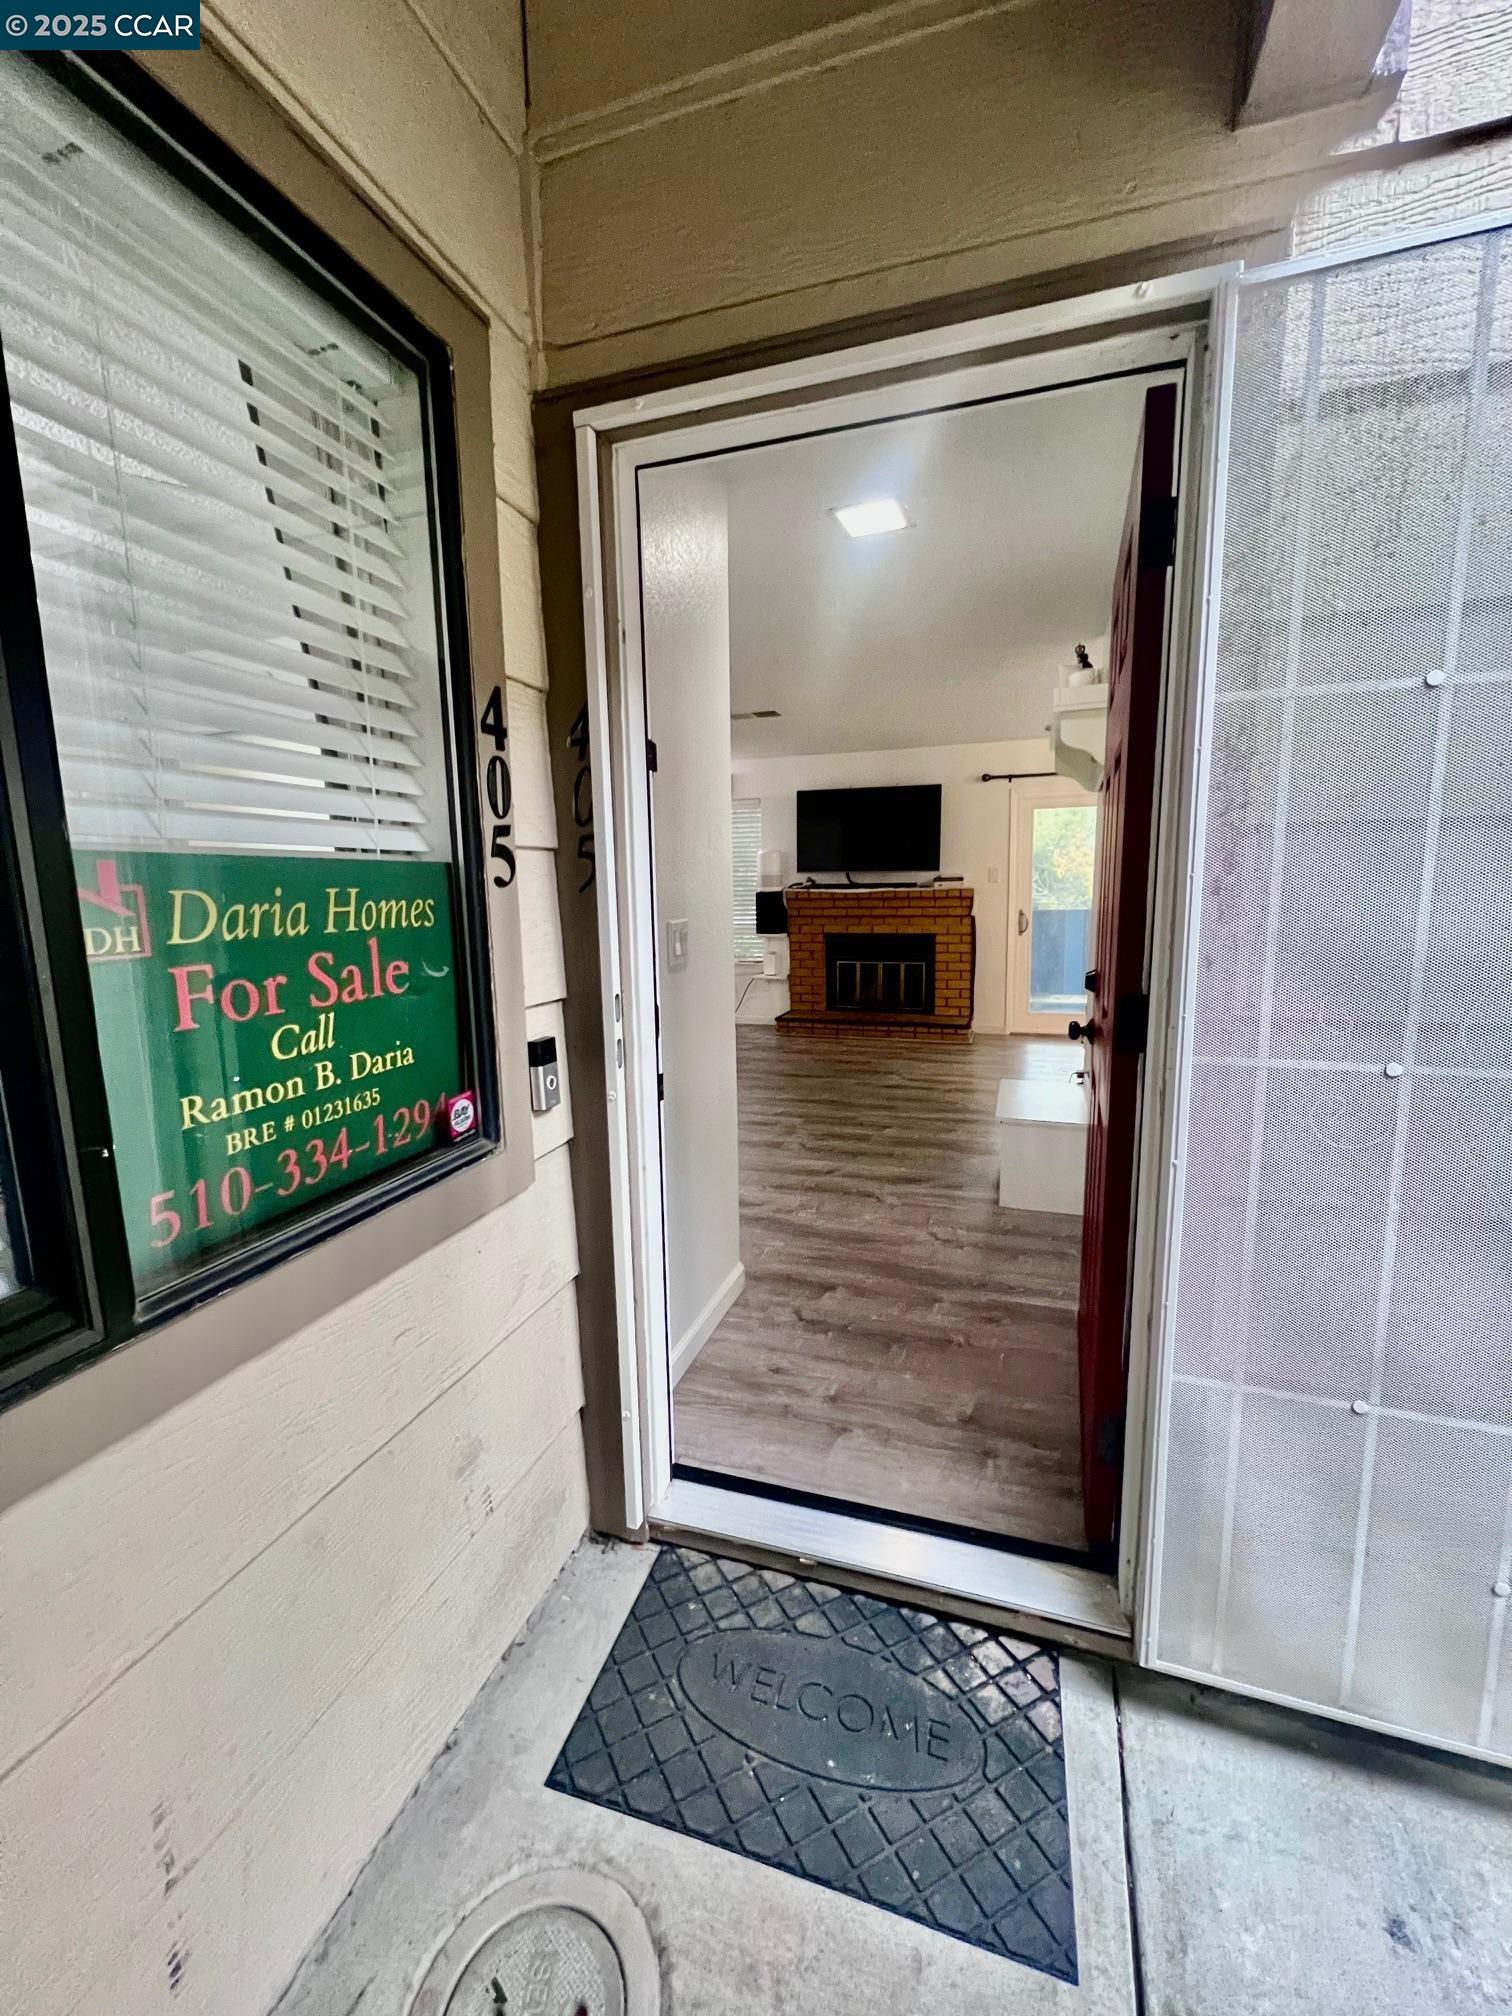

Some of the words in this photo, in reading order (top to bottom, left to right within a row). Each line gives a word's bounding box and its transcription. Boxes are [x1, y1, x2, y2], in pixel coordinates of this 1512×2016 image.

[480, 685, 517, 889] 405
[86, 925, 141, 958] DH
[166, 887, 309, 946] Daria
[322, 887, 436, 935] Homes
[168, 963, 289, 1033] For
[307, 936, 410, 1009] Sale
[270, 1012, 336, 1061] Call
[179, 1076, 306, 1131] Ramon
[314, 1060, 342, 1091] B.
[349, 1040, 415, 1083] Daria
[225, 1119, 277, 1156] BRE
[282, 1114, 296, 1133] #
[301, 1087, 381, 1130] 01231635
[712, 1651, 951, 1763] WELCOME
